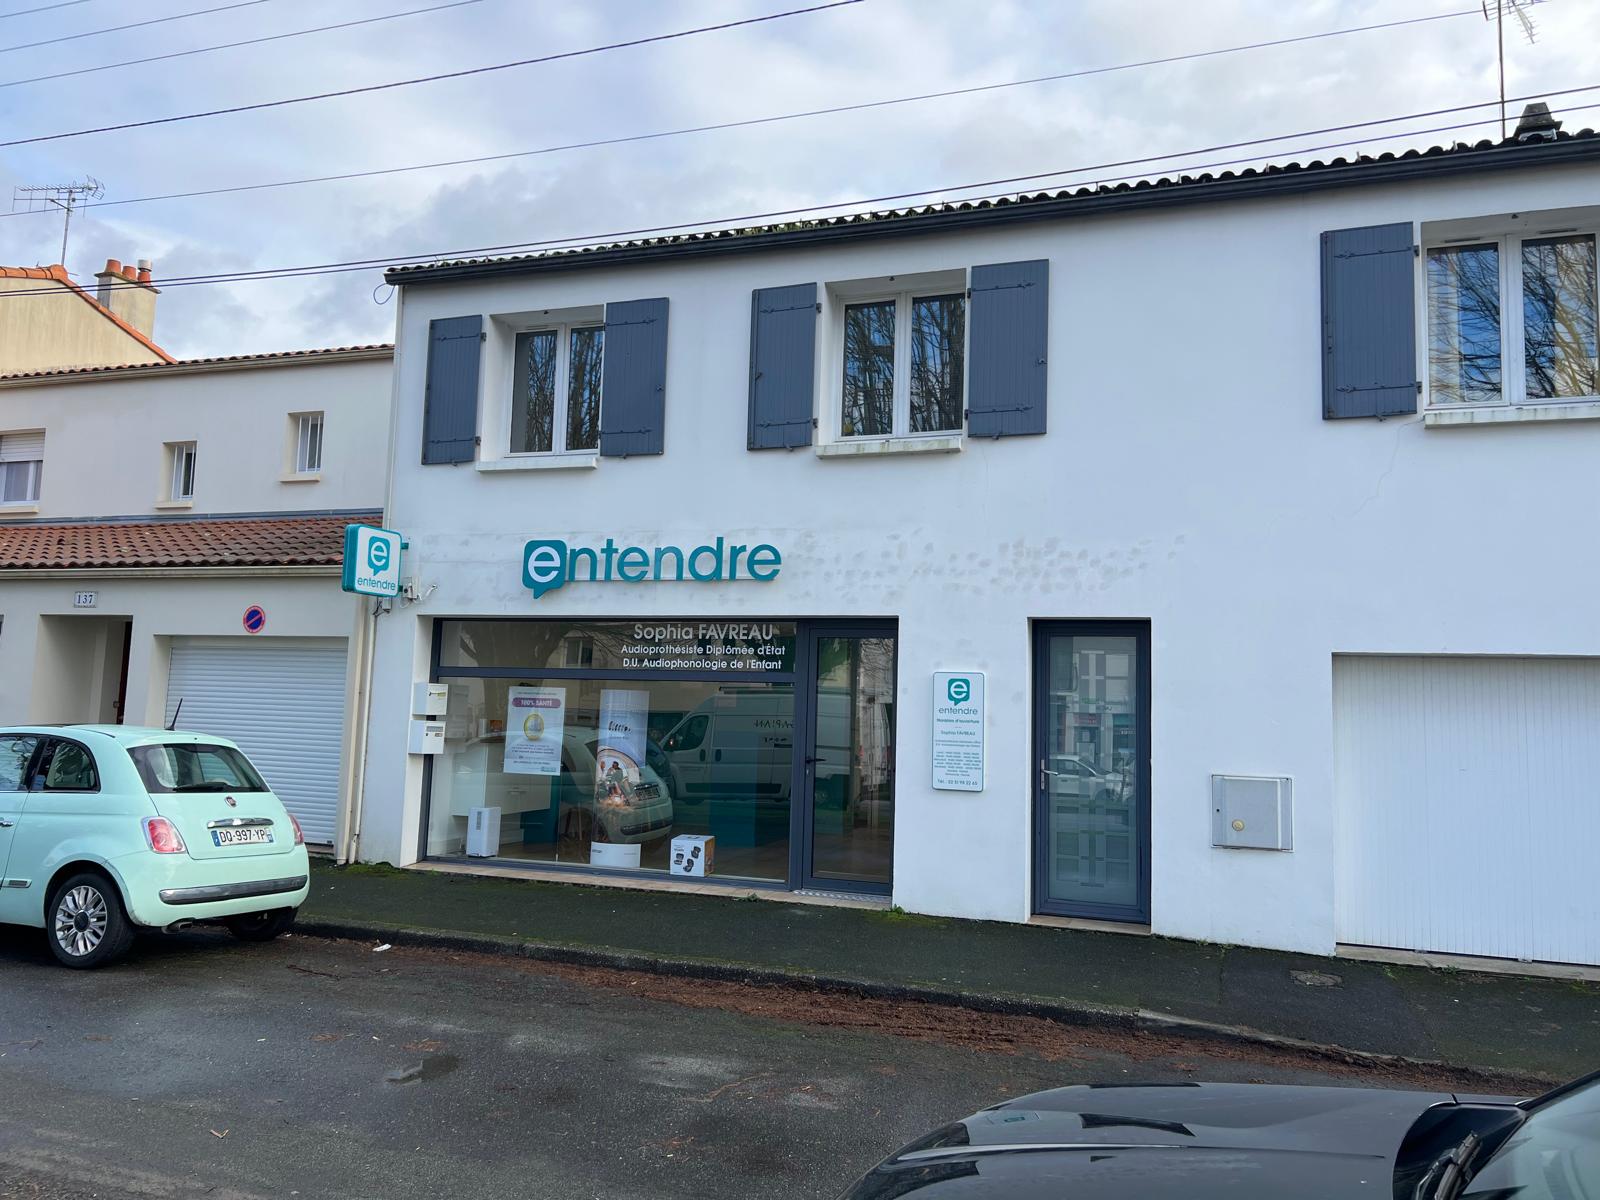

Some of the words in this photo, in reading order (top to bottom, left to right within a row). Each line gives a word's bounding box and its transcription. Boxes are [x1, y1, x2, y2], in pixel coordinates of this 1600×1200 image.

[527, 537, 783, 584] entendre
[357, 577, 396, 591] entendre
[77, 594, 93, 604] 137
[633, 624, 694, 643] Sophia
[698, 624, 773, 640] FAVREAU
[620, 644, 704, 656] Audioprothésiste
[706, 643, 755, 656] Diplômée
[757, 643, 786, 656] d'État
[623, 658, 641, 668] D.U.
[642, 658, 728, 670] Audiophonologie
[730, 658, 744, 669] de
[746, 659, 783, 670] l'Enfant
[938, 706, 979, 715] entendre
[218, 829, 266, 843] DQ-997-YP
